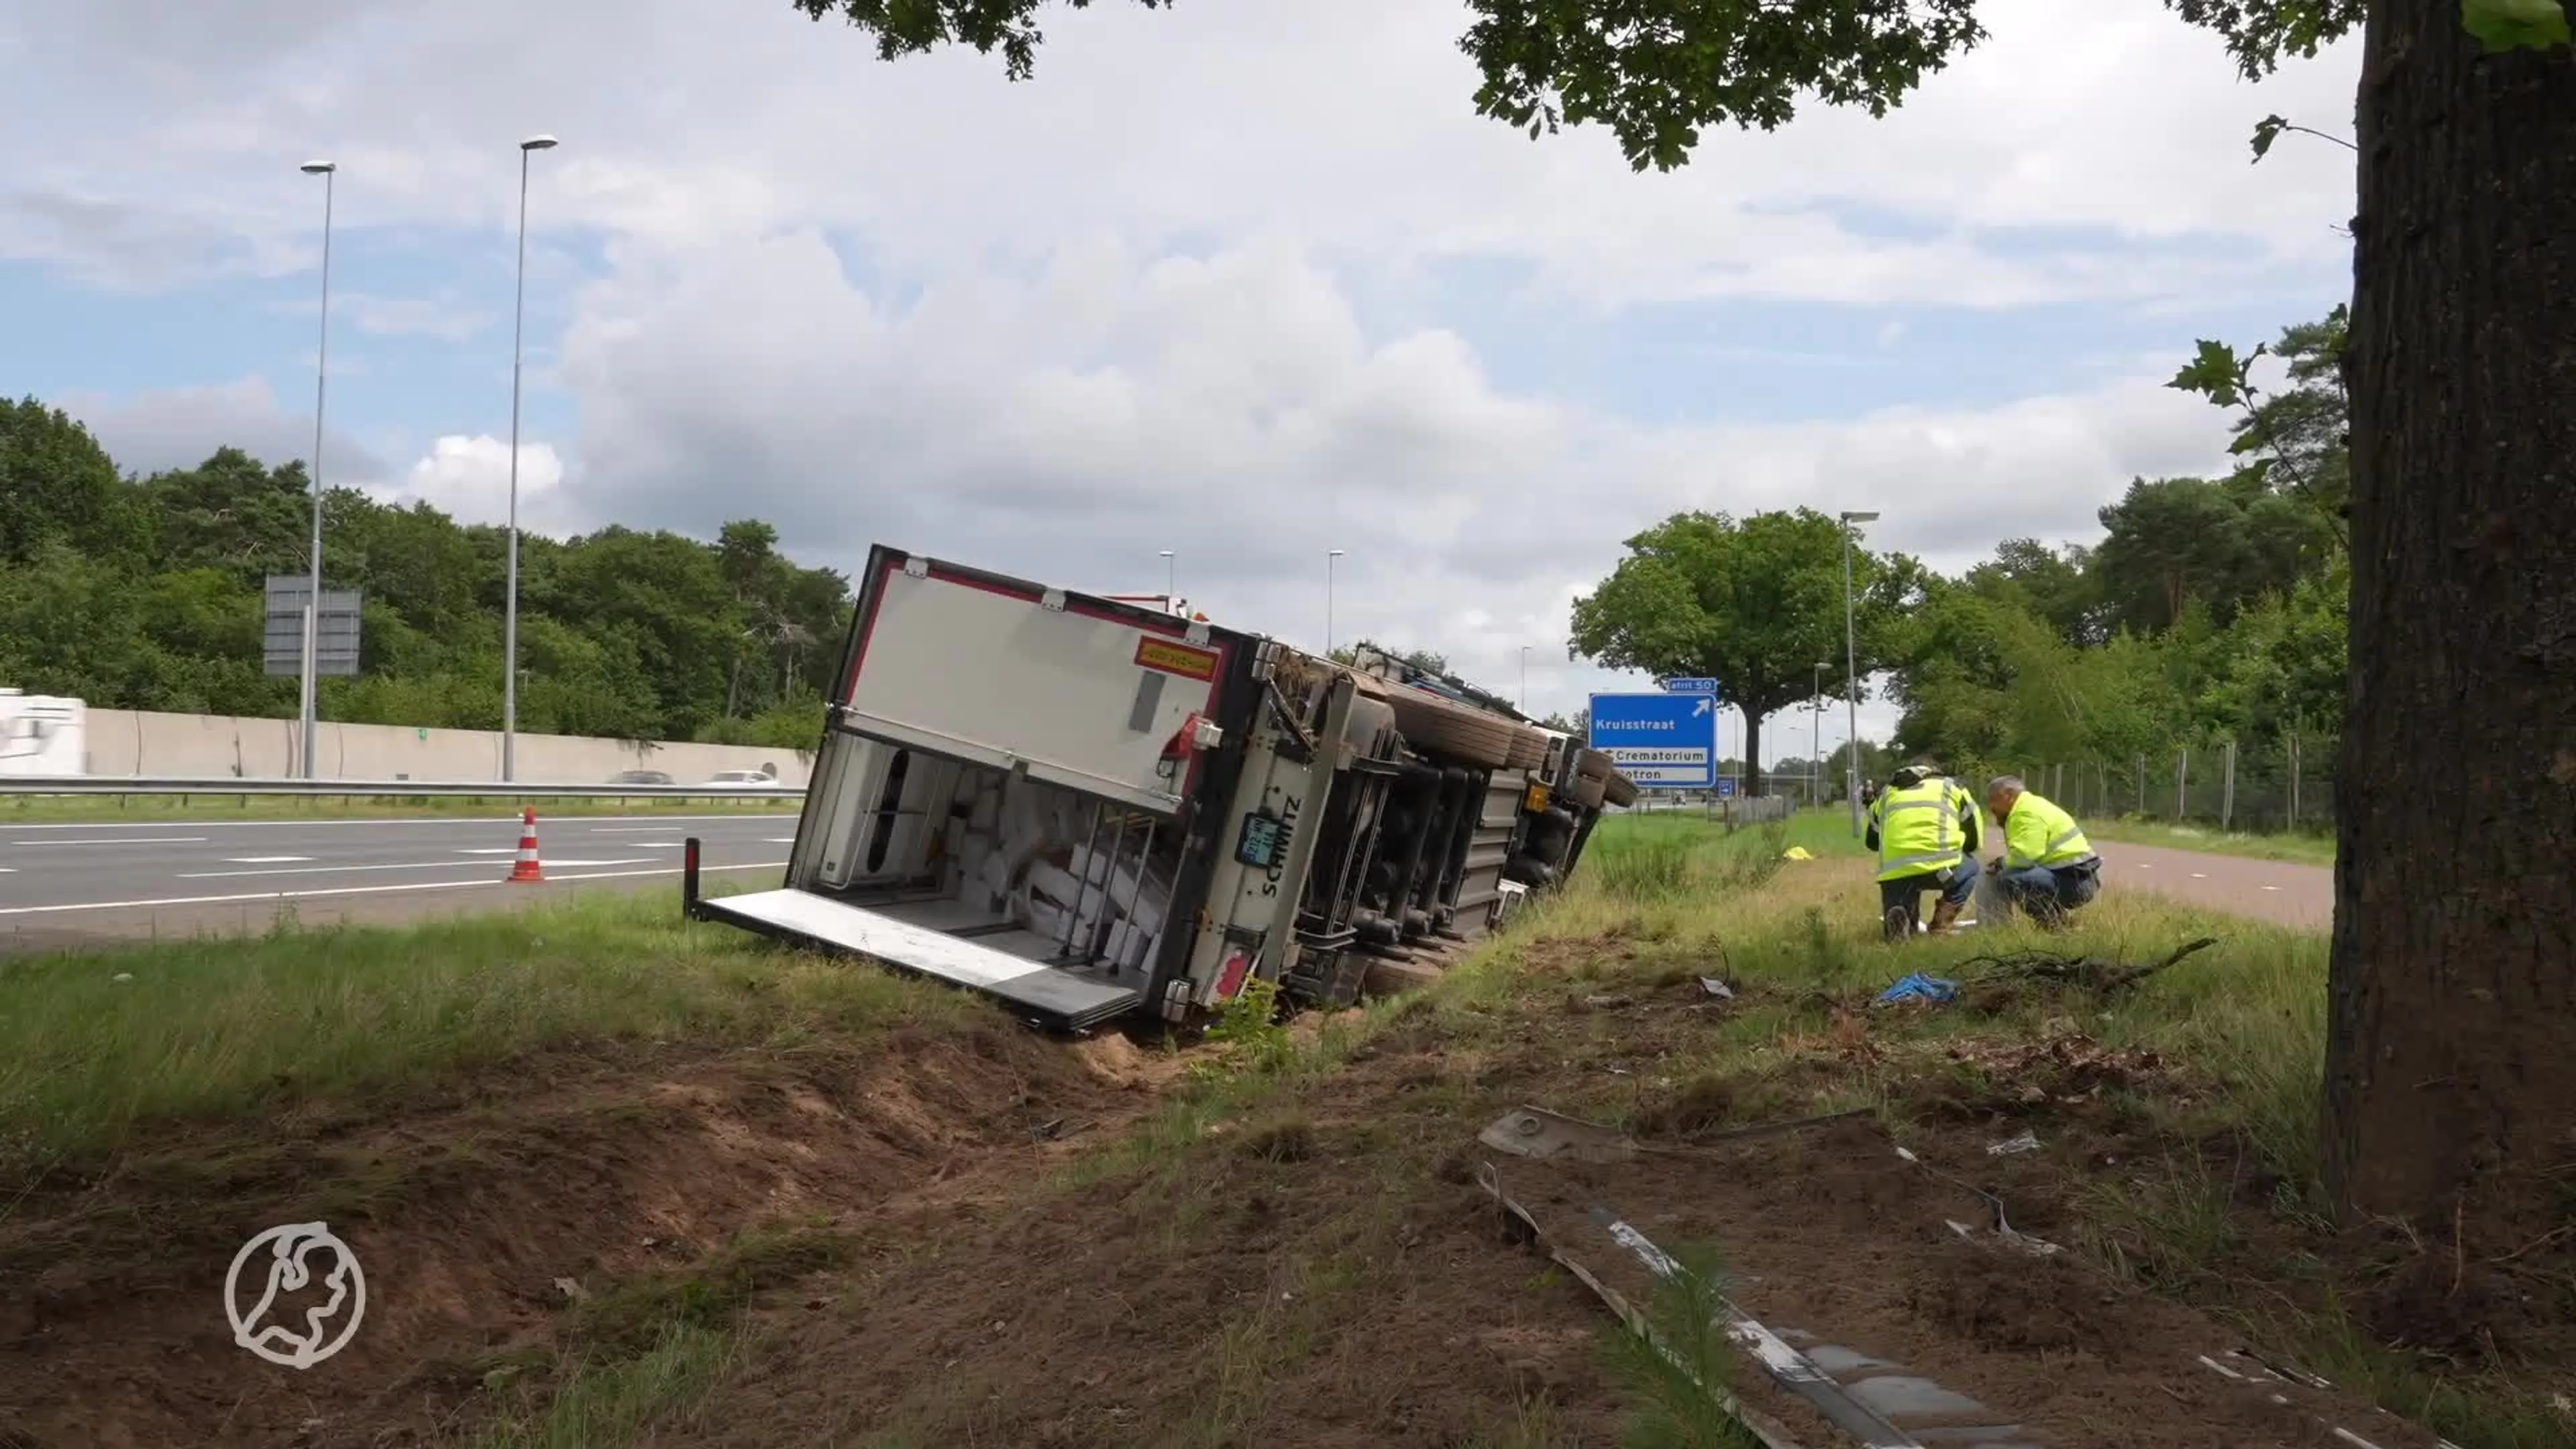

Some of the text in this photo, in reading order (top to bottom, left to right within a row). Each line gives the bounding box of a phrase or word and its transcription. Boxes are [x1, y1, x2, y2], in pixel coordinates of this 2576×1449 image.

[1695, 681, 1711, 689] 50
[1596, 719, 1675, 730] Kruisstraat
[1616, 750, 1703, 761] Crematorium
[1621, 770, 1661, 779] otron
[1262, 794, 1301, 898] SCHMITZ
